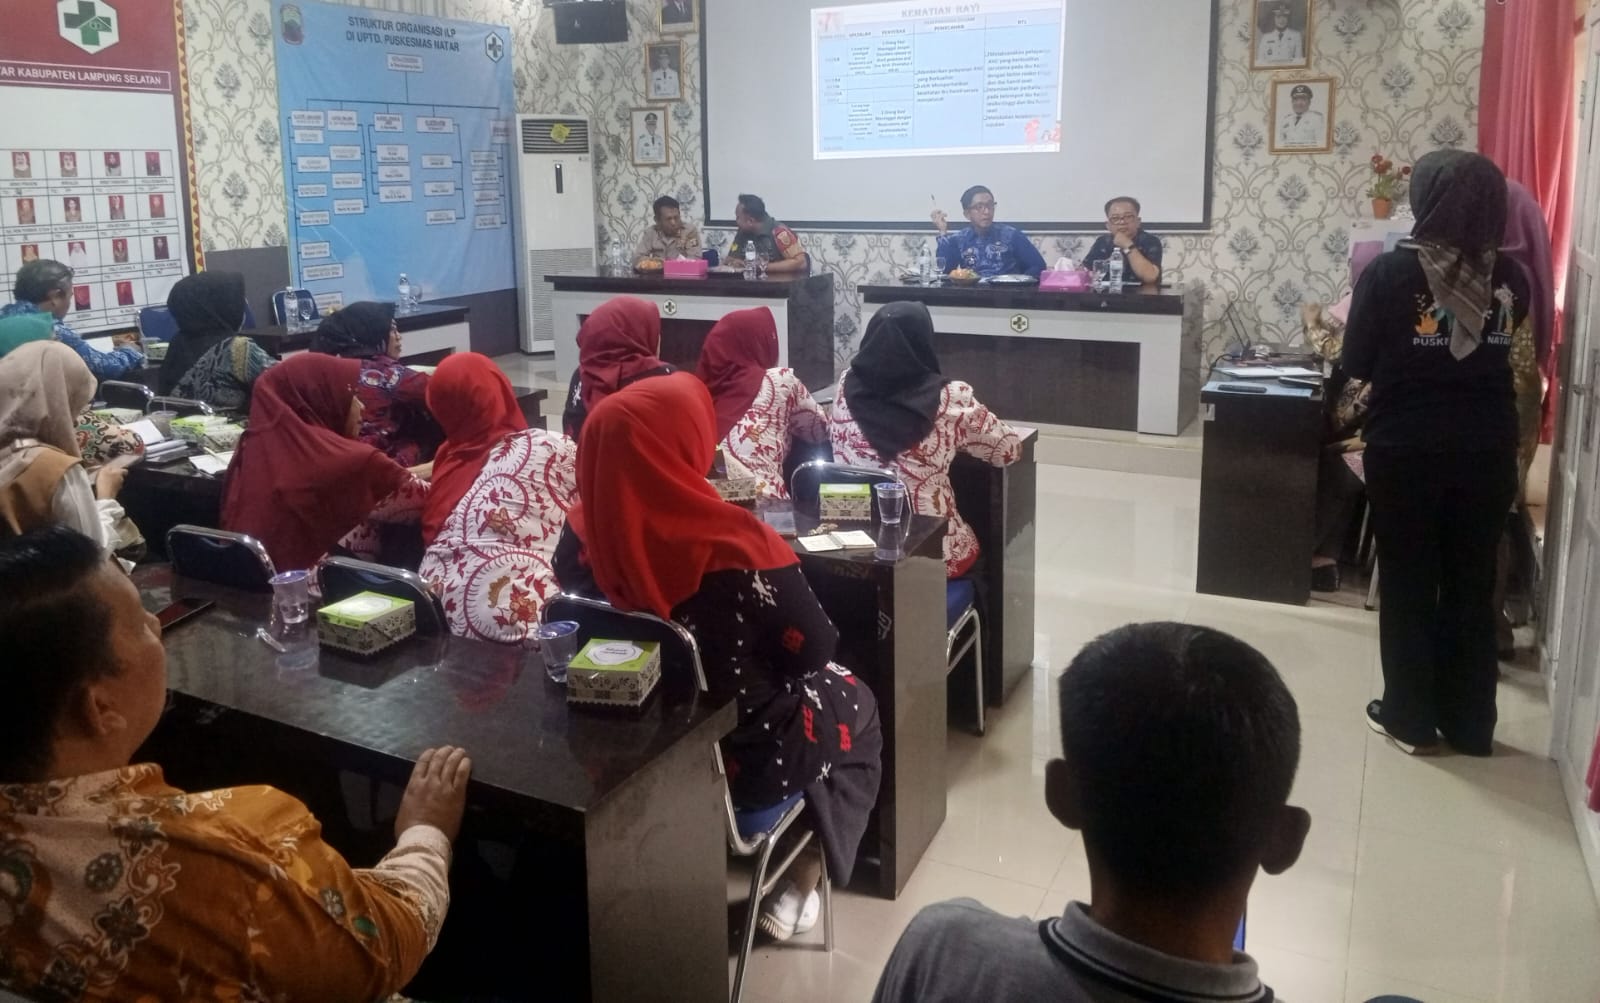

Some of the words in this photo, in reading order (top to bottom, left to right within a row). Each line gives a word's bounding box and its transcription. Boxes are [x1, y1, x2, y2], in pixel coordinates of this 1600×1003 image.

[348, 16, 394, 31] STRUKTUR
[395, 21, 443, 36] ORGANISASI
[346, 30, 355, 41] DI
[384, 34, 433, 49] PUSKESMAS
[434, 39, 460, 52] NATAR
[0, 65, 16, 77] AR
[17, 67, 77, 80] KABUPATEN
[77, 71, 122, 83] LAMPUNG
[123, 74, 161, 85] SELATAN
